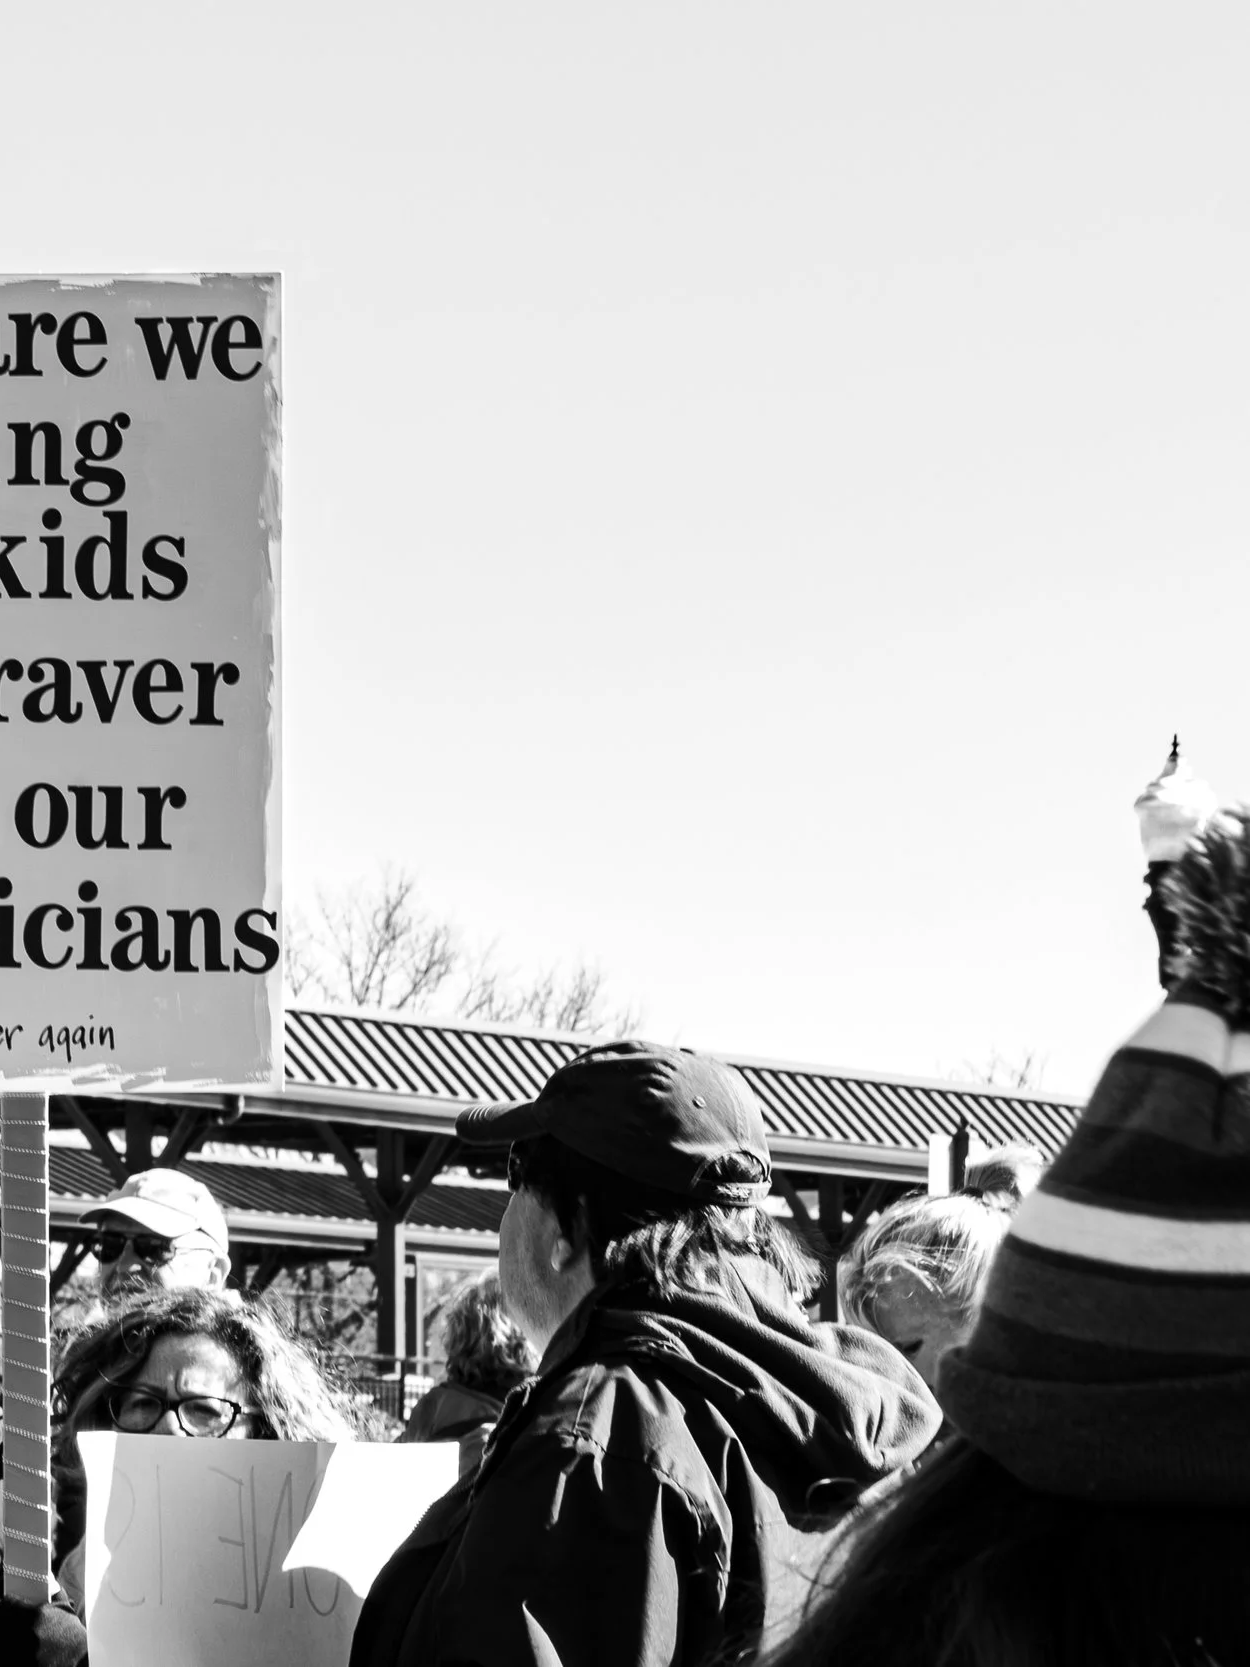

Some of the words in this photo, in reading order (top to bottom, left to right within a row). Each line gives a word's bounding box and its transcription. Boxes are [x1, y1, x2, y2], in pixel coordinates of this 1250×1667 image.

[134, 311, 264, 382] we
[14, 781, 187, 851] our
[38, 1013, 116, 1063] again
